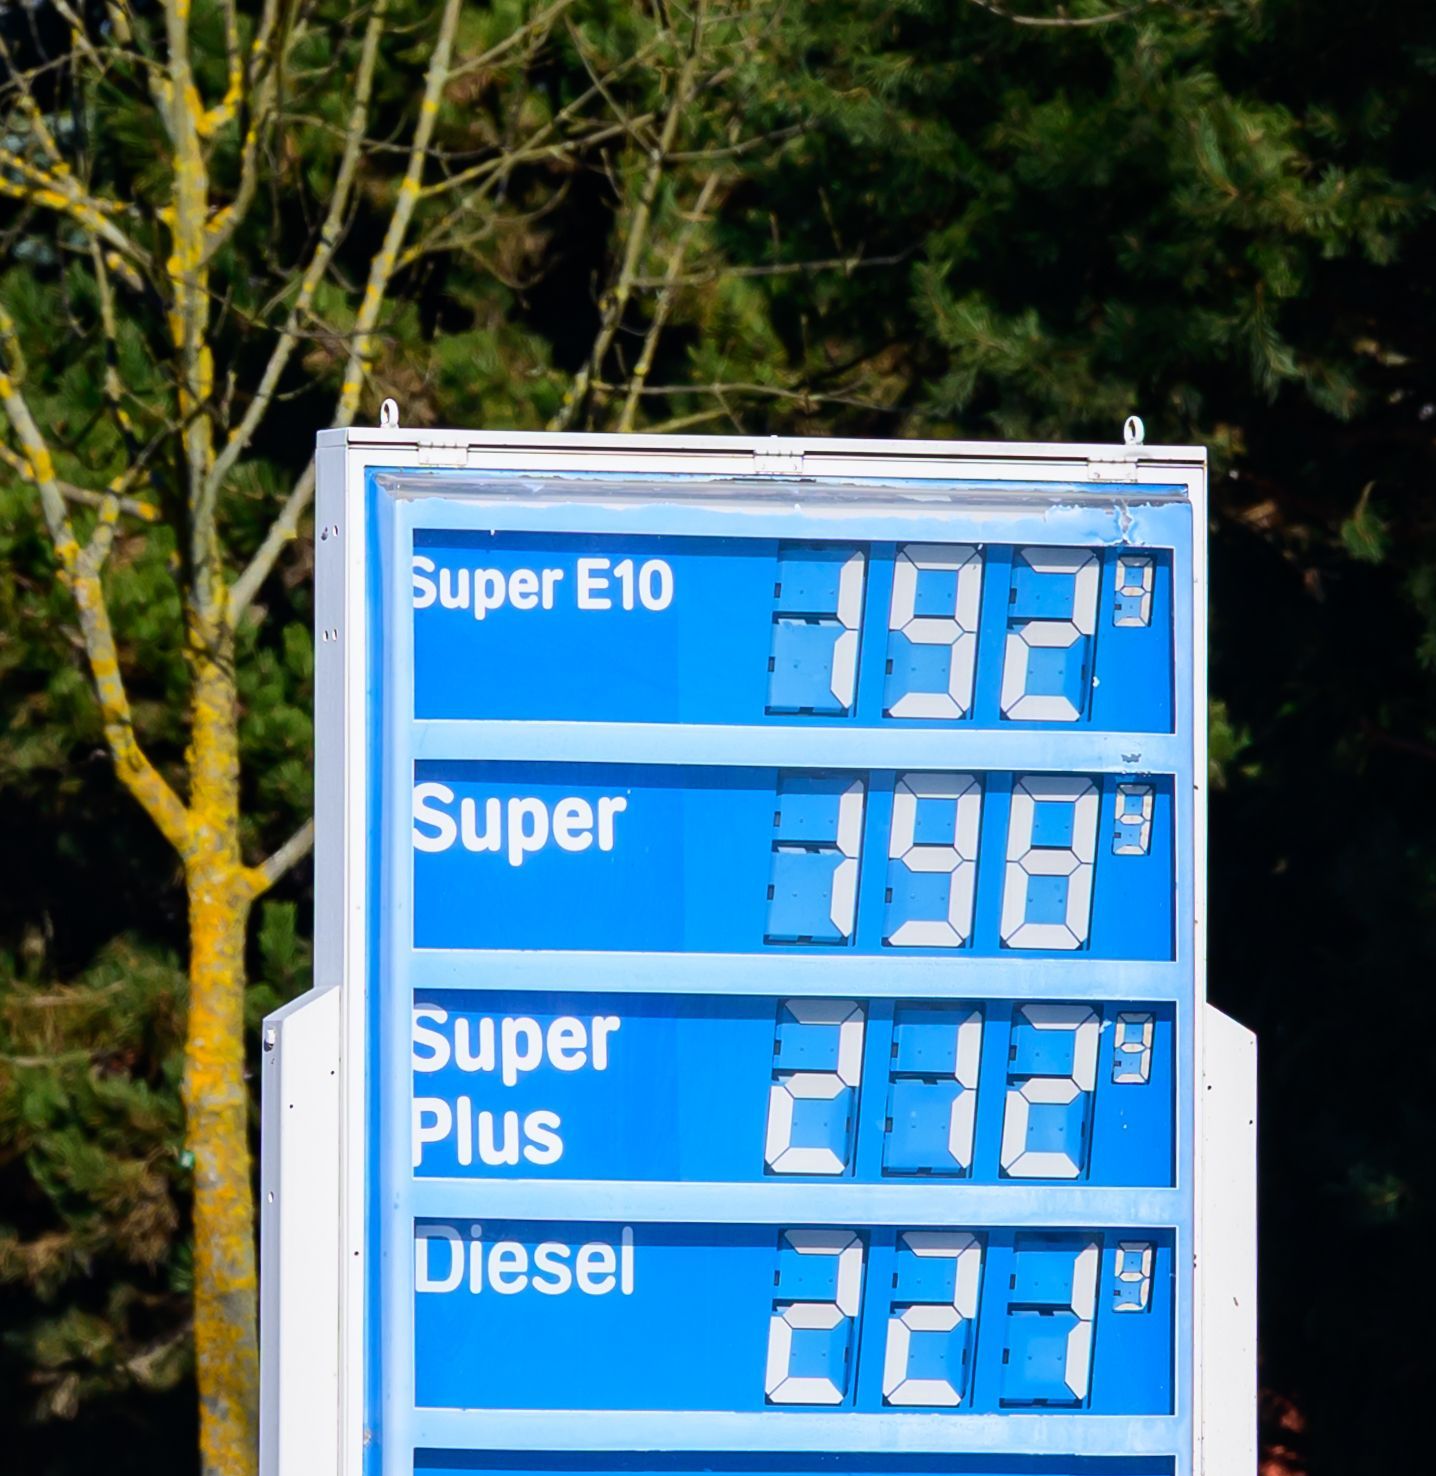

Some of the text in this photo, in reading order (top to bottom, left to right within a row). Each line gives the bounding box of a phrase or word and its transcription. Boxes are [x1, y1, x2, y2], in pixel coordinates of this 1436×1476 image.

[412, 556, 674, 620] Super E10
[412, 782, 627, 866] Super
[412, 1003, 621, 1087] Super
[412, 1096, 563, 1165] Plus
[413, 1224, 634, 1295] Diesel
